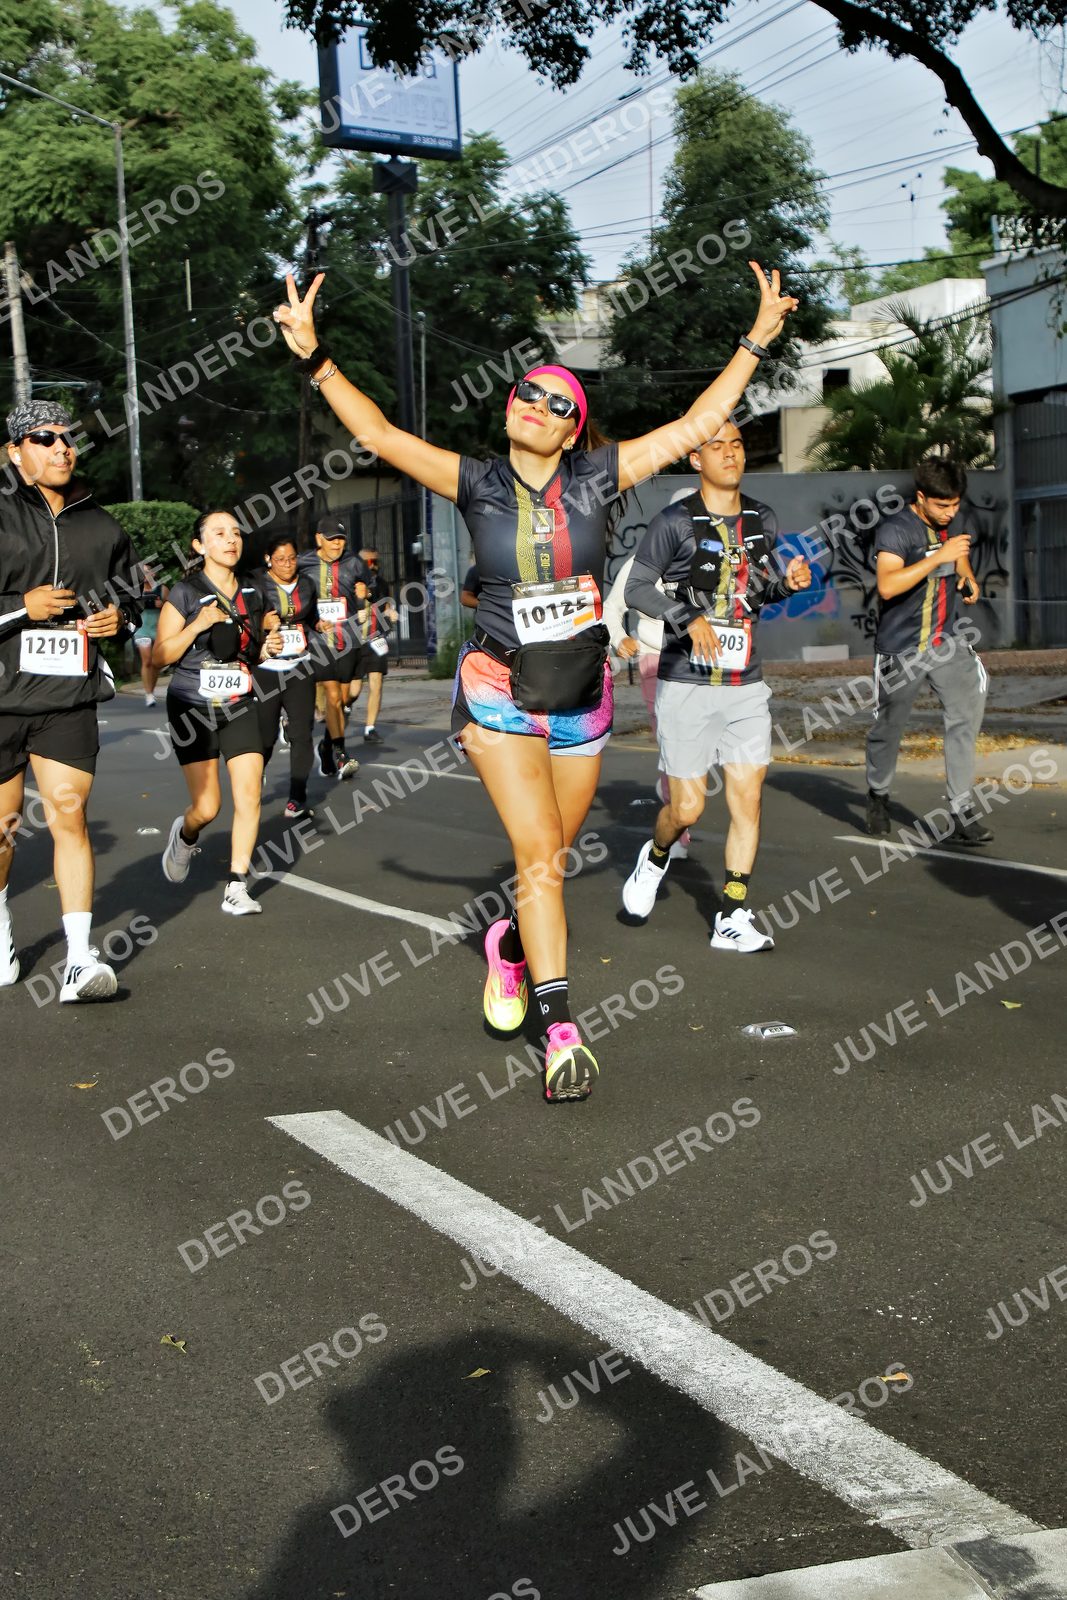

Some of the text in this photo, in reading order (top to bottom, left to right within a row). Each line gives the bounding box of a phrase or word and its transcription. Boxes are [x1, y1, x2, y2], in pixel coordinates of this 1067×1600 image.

[26, 637, 78, 655] 12191
[720, 634, 744, 651] 903
[208, 675, 241, 688] 8784
